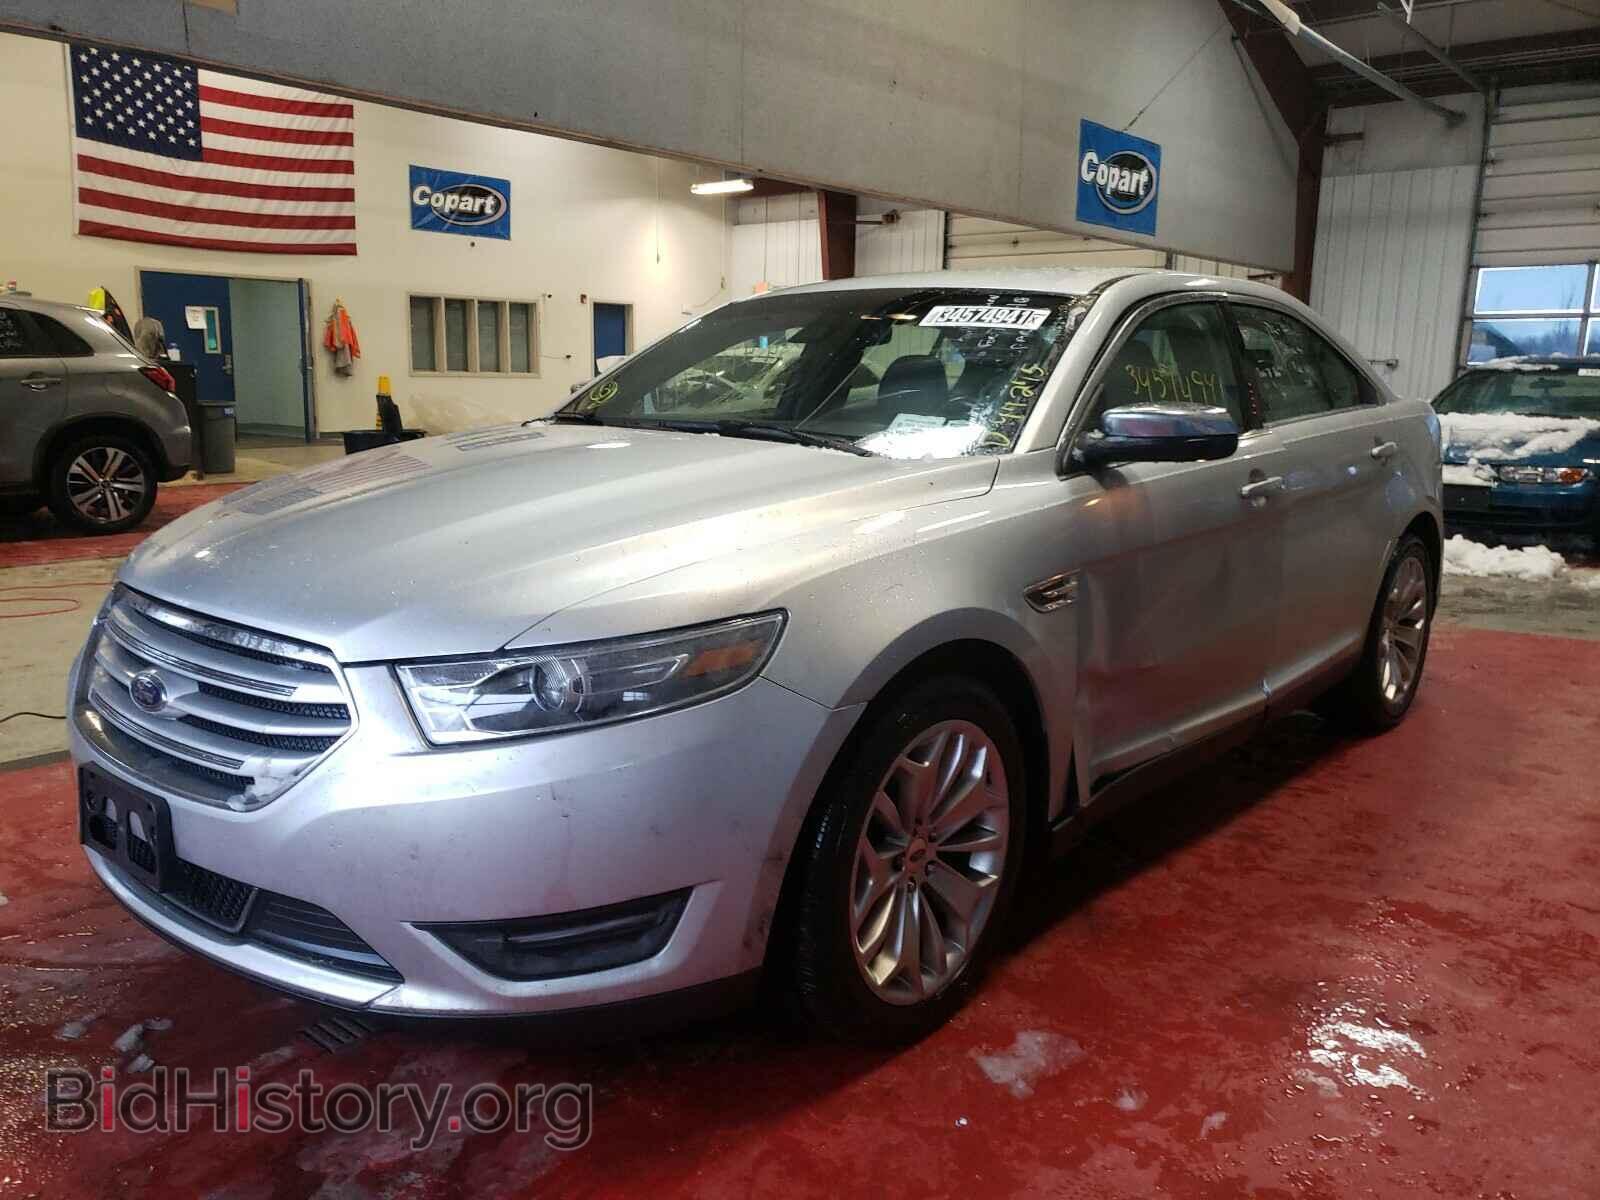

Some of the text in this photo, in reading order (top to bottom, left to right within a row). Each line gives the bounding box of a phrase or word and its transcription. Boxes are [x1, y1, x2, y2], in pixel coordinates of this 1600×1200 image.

[1081, 151, 1149, 196] Copart
[412, 185, 496, 214] Copart
[936, 307, 1028, 327] 34574941
